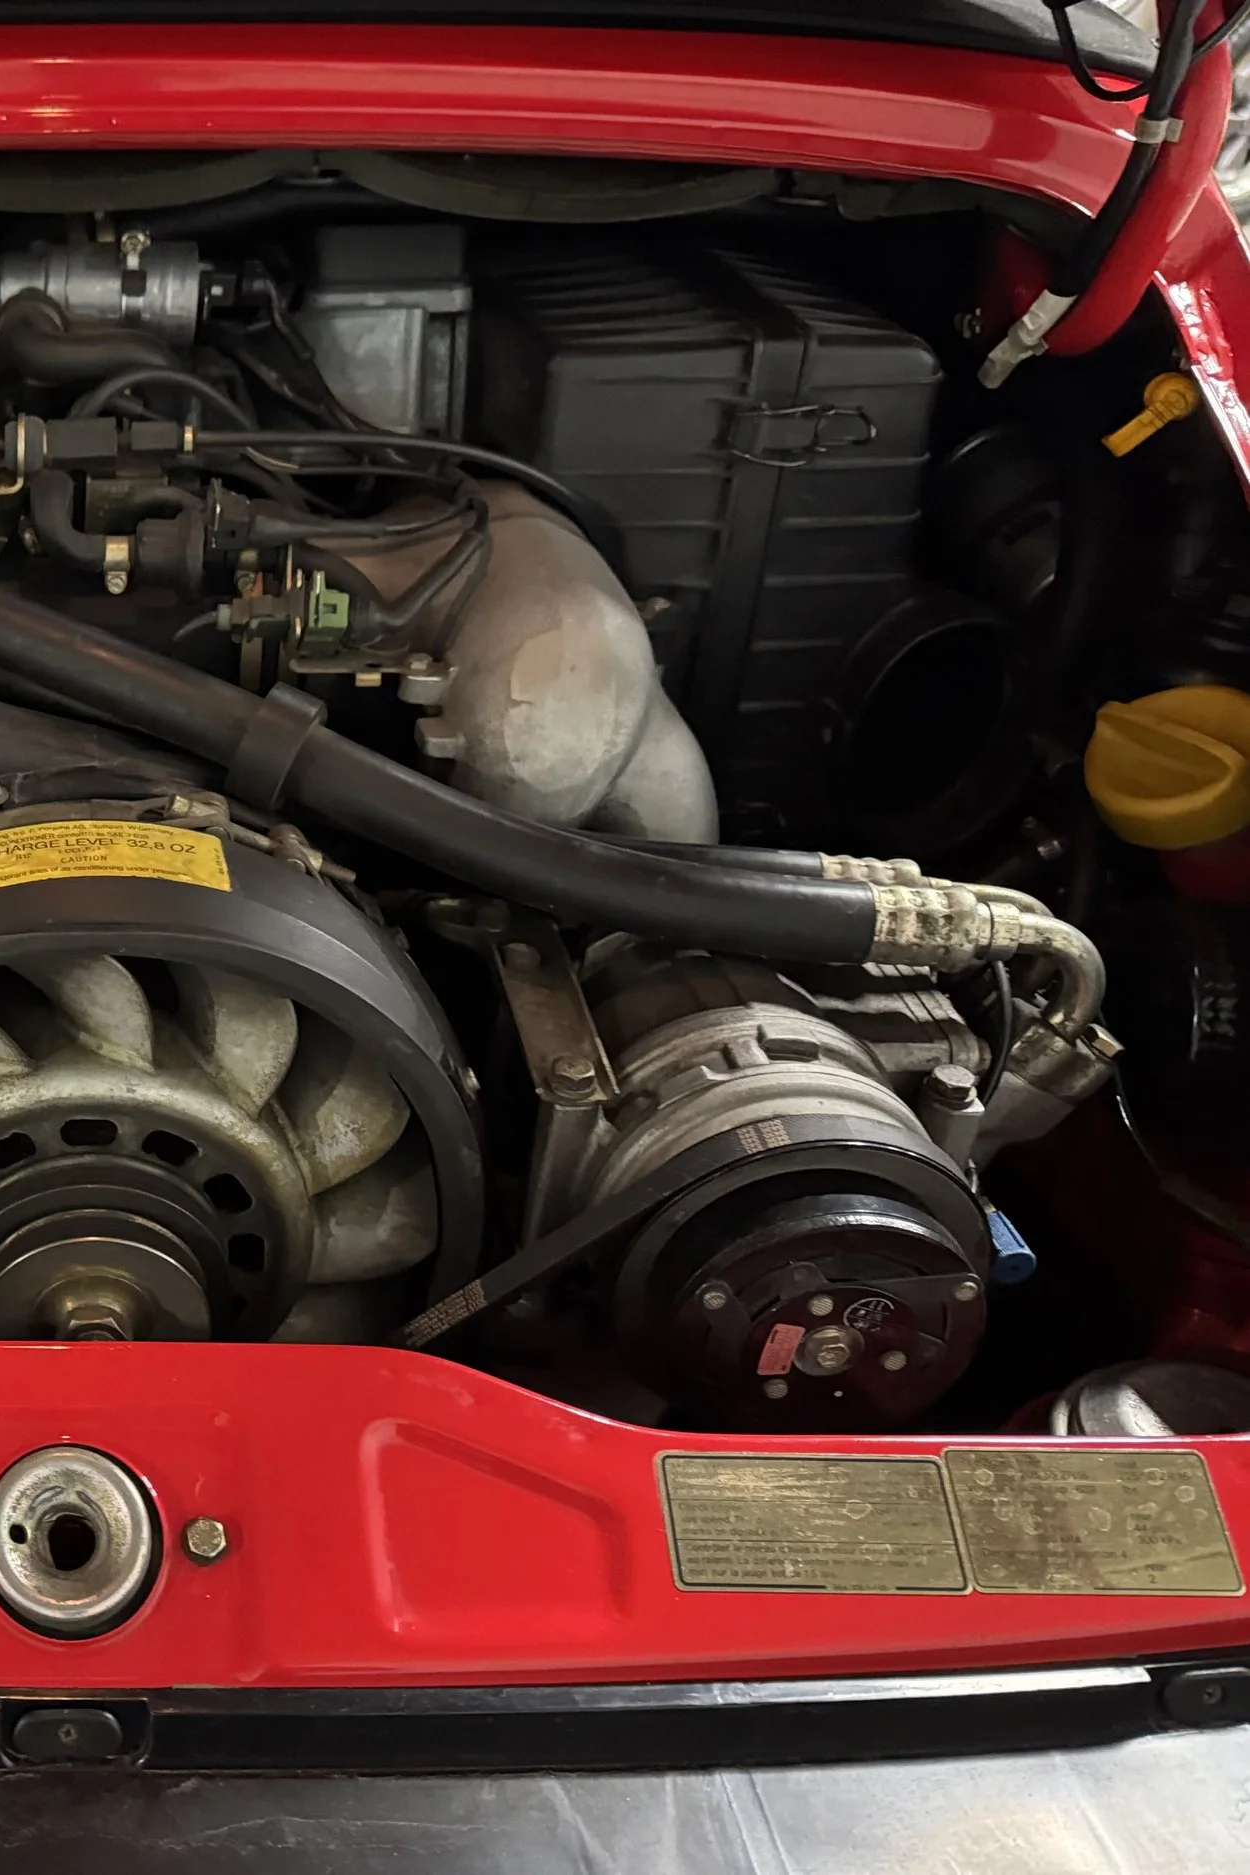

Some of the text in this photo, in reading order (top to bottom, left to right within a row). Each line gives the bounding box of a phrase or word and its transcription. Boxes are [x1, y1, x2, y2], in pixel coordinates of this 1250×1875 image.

[65, 837, 120, 847] LEVEL
[126, 839, 165, 851] 32,8
[170, 843, 197, 854] OZ
[60, 855, 108, 864] CAUTION
